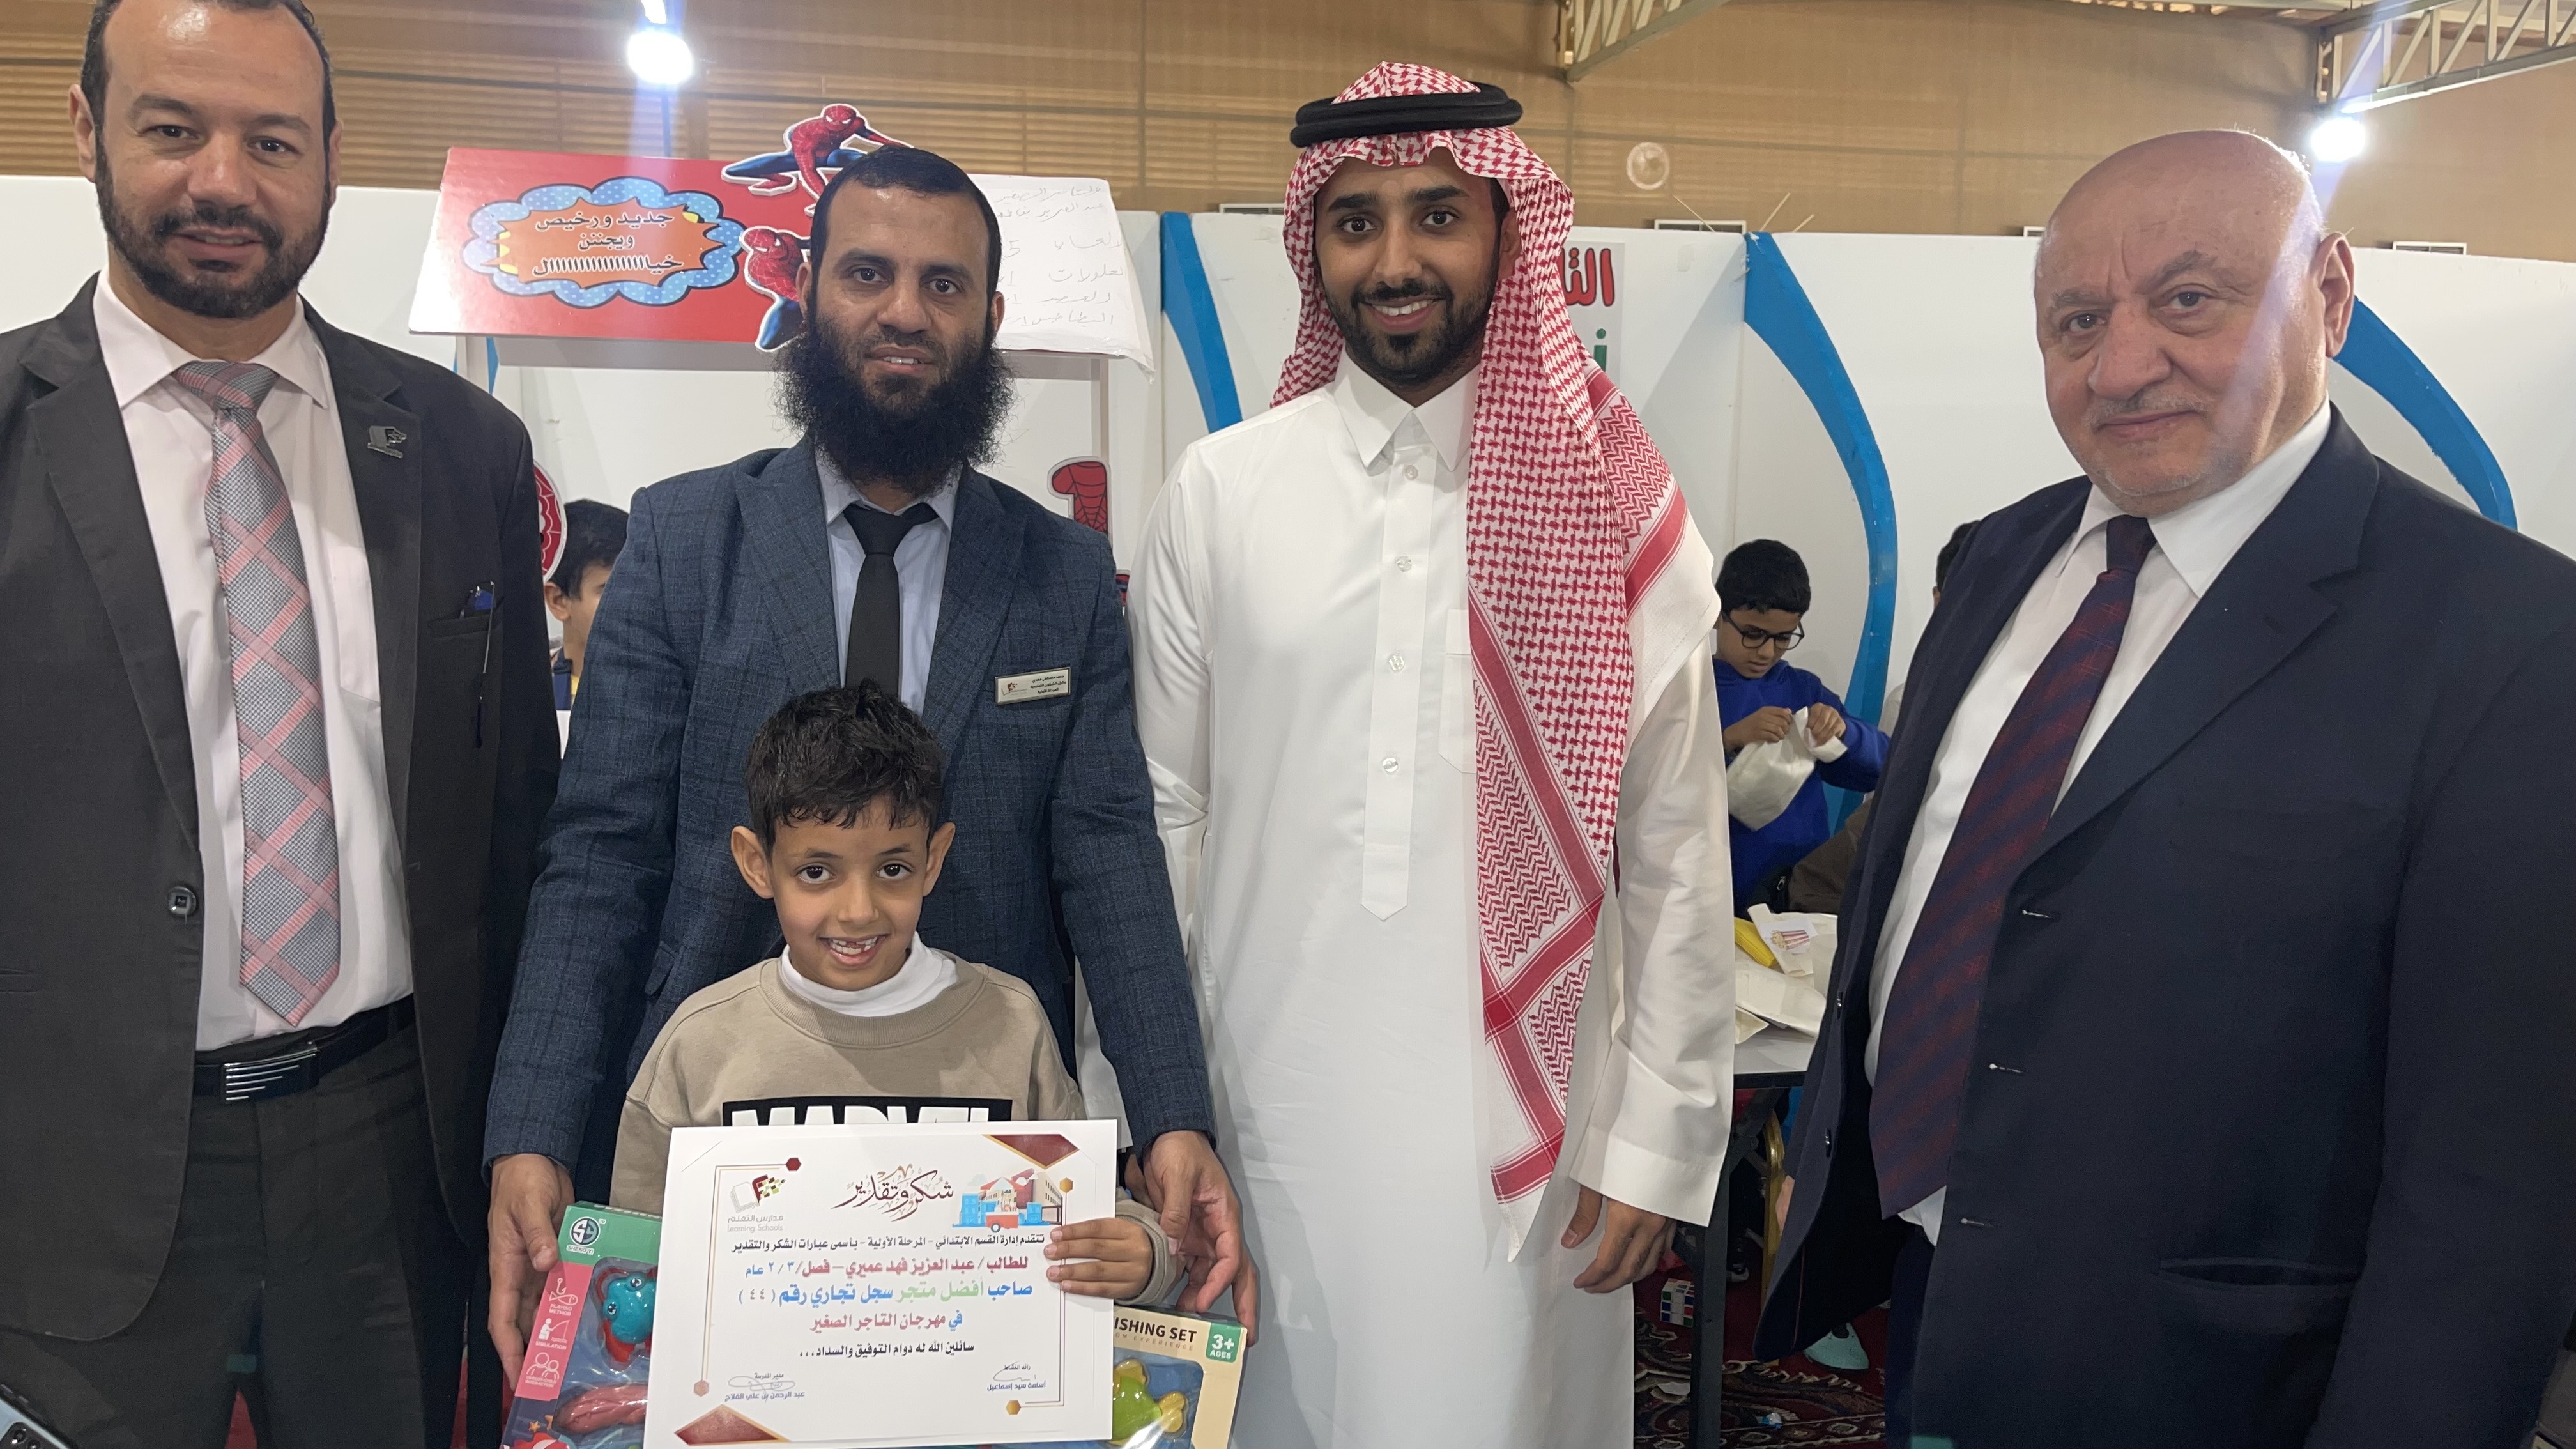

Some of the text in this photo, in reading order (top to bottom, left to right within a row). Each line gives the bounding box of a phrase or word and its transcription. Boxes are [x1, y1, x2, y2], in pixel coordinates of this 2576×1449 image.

[617, 211, 675, 229] جديد
[891, 1170, 954, 1222] شكر
[728, 1215, 784, 1223] مدارس التعلم
[727, 1223, 783, 1233] Learning Schools
[731, 1239, 770, 1254] والتقدير
[773, 1238, 797, 1252] الشكر
[799, 1238, 828, 1252] عبارات
[830, 1236, 858, 1252] بأسمى
[868, 1236, 896, 1250] الأولية
[898, 1236, 926, 1248] المرحلة
[935, 1234, 973, 1250] الابتدائي
[974, 1234, 999, 1247] القسم
[1000, 1234, 1018, 1247] إدارة
[1020, 1233, 1045, 1246] تتقدم
[746, 1264, 764, 1278] عام
[846, 1260, 883, 1278] عميري
[886, 1257, 908, 1275] فهد
[910, 1257, 949, 1276] العزيز
[951, 1257, 974, 1274] عبد
[986, 1255, 1028, 1273] للطالب
[778, 1284, 807, 1307] رقم
[810, 1282, 856, 1308] تجاري
[860, 1284, 894, 1304] سجل
[896, 1281, 937, 1303] متجر
[940, 1276, 984, 1302] أفضل
[987, 1280, 1033, 1301] صاحب
[809, 1309, 963, 1334] في مهرجان التاجر الصغير
[1114, 1315, 1197, 1343] ISHING SET
[535, 1340, 567, 1350] SIMULATION
[893, 1342, 913, 1357] دوام
[916, 1342, 926, 1353] له
[928, 1339, 944, 1353] الله
[945, 1340, 975, 1356] سائلين
[1133, 1335, 1193, 1351] EXPERIENCE
[1211, 1334, 1235, 1350] 3+
[855, 1342, 891, 1359] التوفيق
[1209, 1350, 1232, 1360] AGES
[987, 1382, 1013, 1392] إسماعيل
[1027, 1380, 1046, 1388] أسامة
[724, 1393, 744, 1403] الفلاح
[746, 1392, 760, 1401] علي
[770, 1391, 792, 1400] الرحمن
[794, 1391, 806, 1399] عبد
